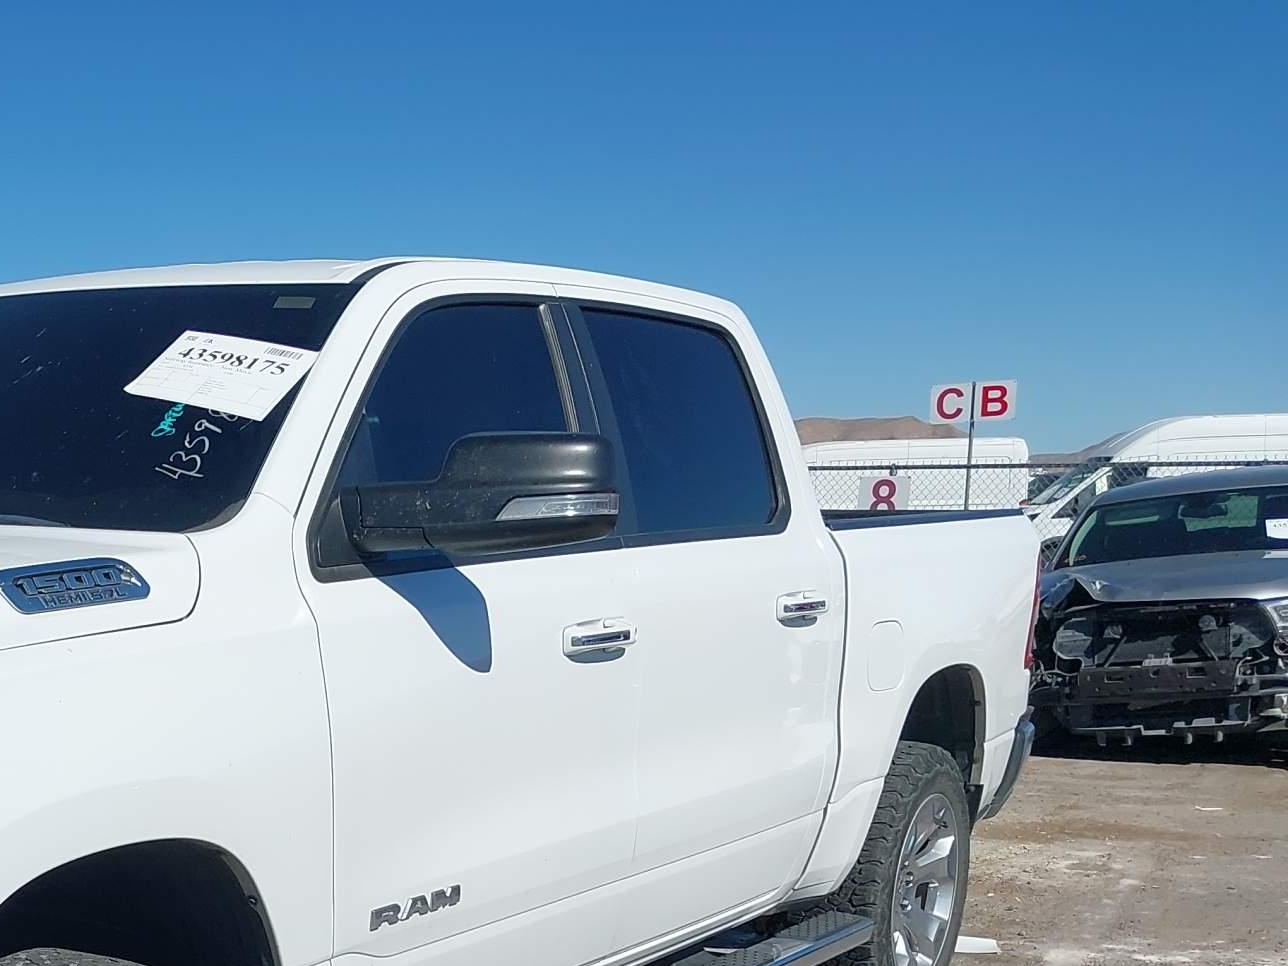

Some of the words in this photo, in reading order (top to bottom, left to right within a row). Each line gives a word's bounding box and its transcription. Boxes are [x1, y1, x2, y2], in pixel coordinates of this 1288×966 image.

[178, 346, 290, 376] 43598175
[936, 388, 964, 420] C
[980, 385, 1008, 417] B
[869, 478, 896, 511] 8
[14, 566, 123, 596] 1500
[39, 590, 92, 608] HEMI
[370, 884, 460, 931] RAM
